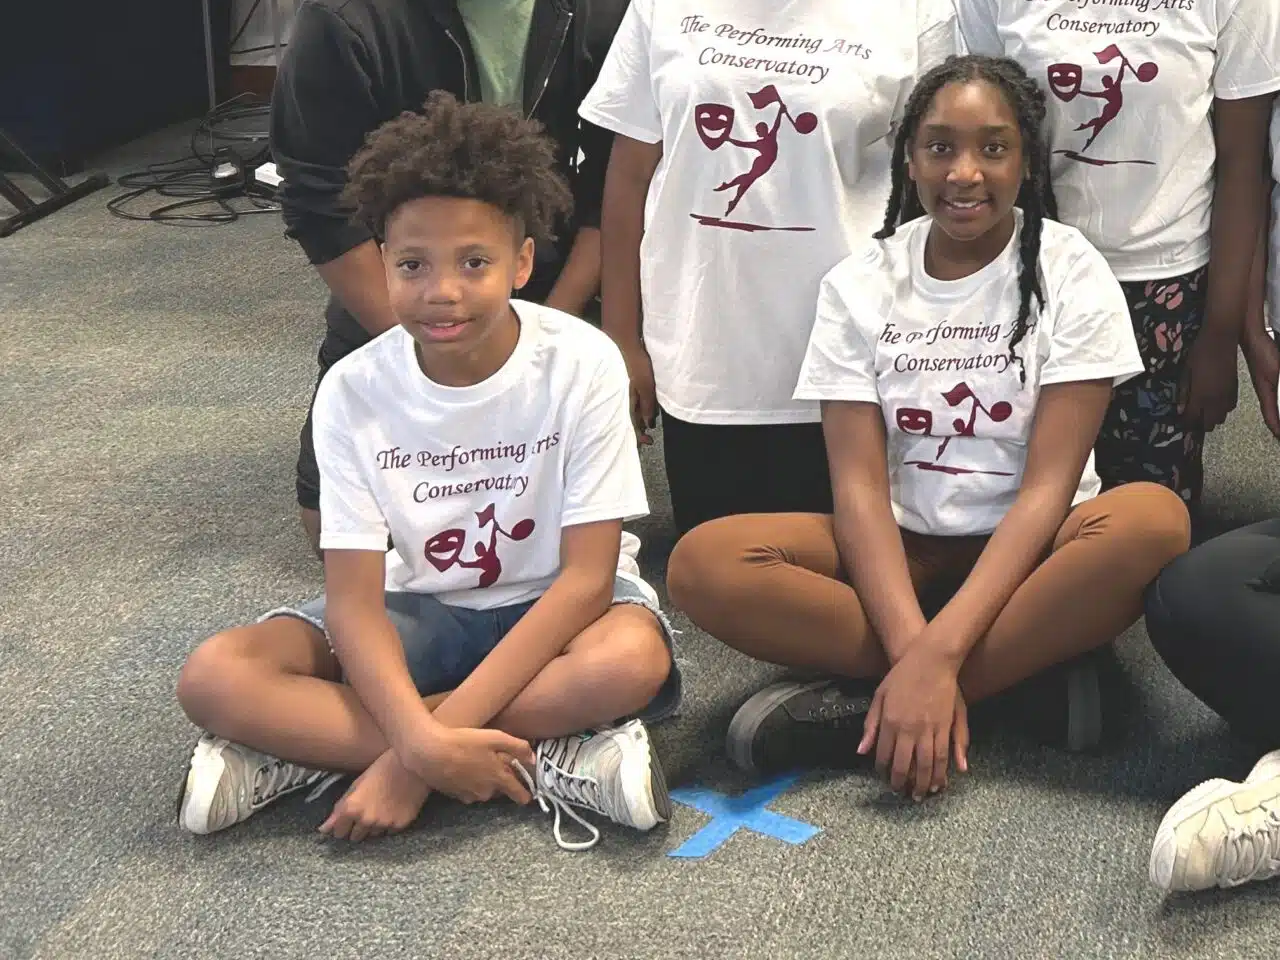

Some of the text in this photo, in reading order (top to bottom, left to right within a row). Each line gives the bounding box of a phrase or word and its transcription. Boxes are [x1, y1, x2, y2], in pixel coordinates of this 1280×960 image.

[679, 14, 873, 60] The Performing Arts
[1045, 12, 1161, 37] Conservatory
[697, 47, 831, 85] Conservatory
[905, 319, 1002, 345] Prforming
[894, 352, 1012, 374] Conservatory
[376, 431, 561, 472] The Performing rts
